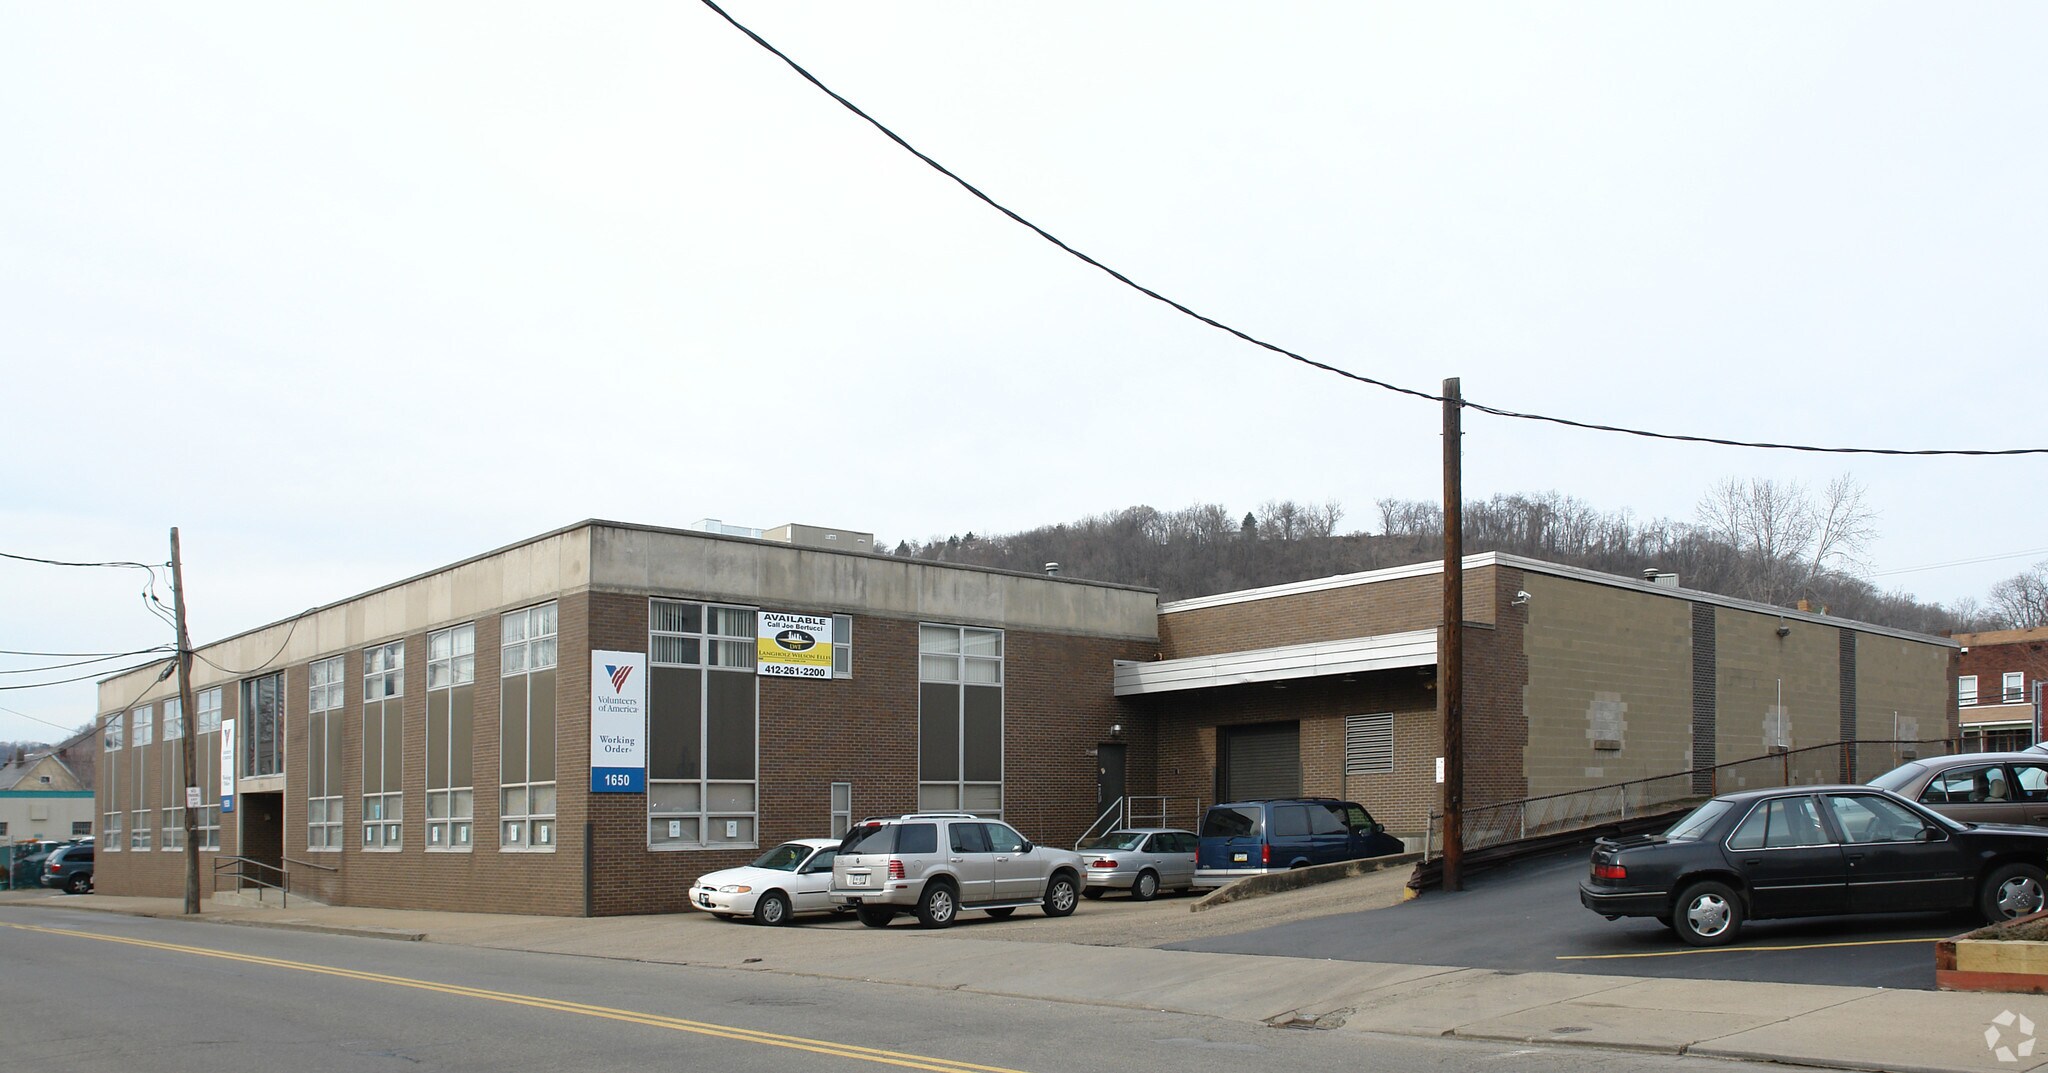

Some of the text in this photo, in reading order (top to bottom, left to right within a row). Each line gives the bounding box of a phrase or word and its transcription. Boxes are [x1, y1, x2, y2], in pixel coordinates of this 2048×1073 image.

[764, 614, 826, 625] AVAILABLE
[795, 623, 823, 632] Bertucci
[765, 665, 825, 677] 412-261-2200
[598, 696, 637, 705] Volunteers
[598, 704, 638, 713] of America
[599, 735, 635, 747] Working
[604, 744, 629, 753] Order
[604, 774, 630, 786] 1650
